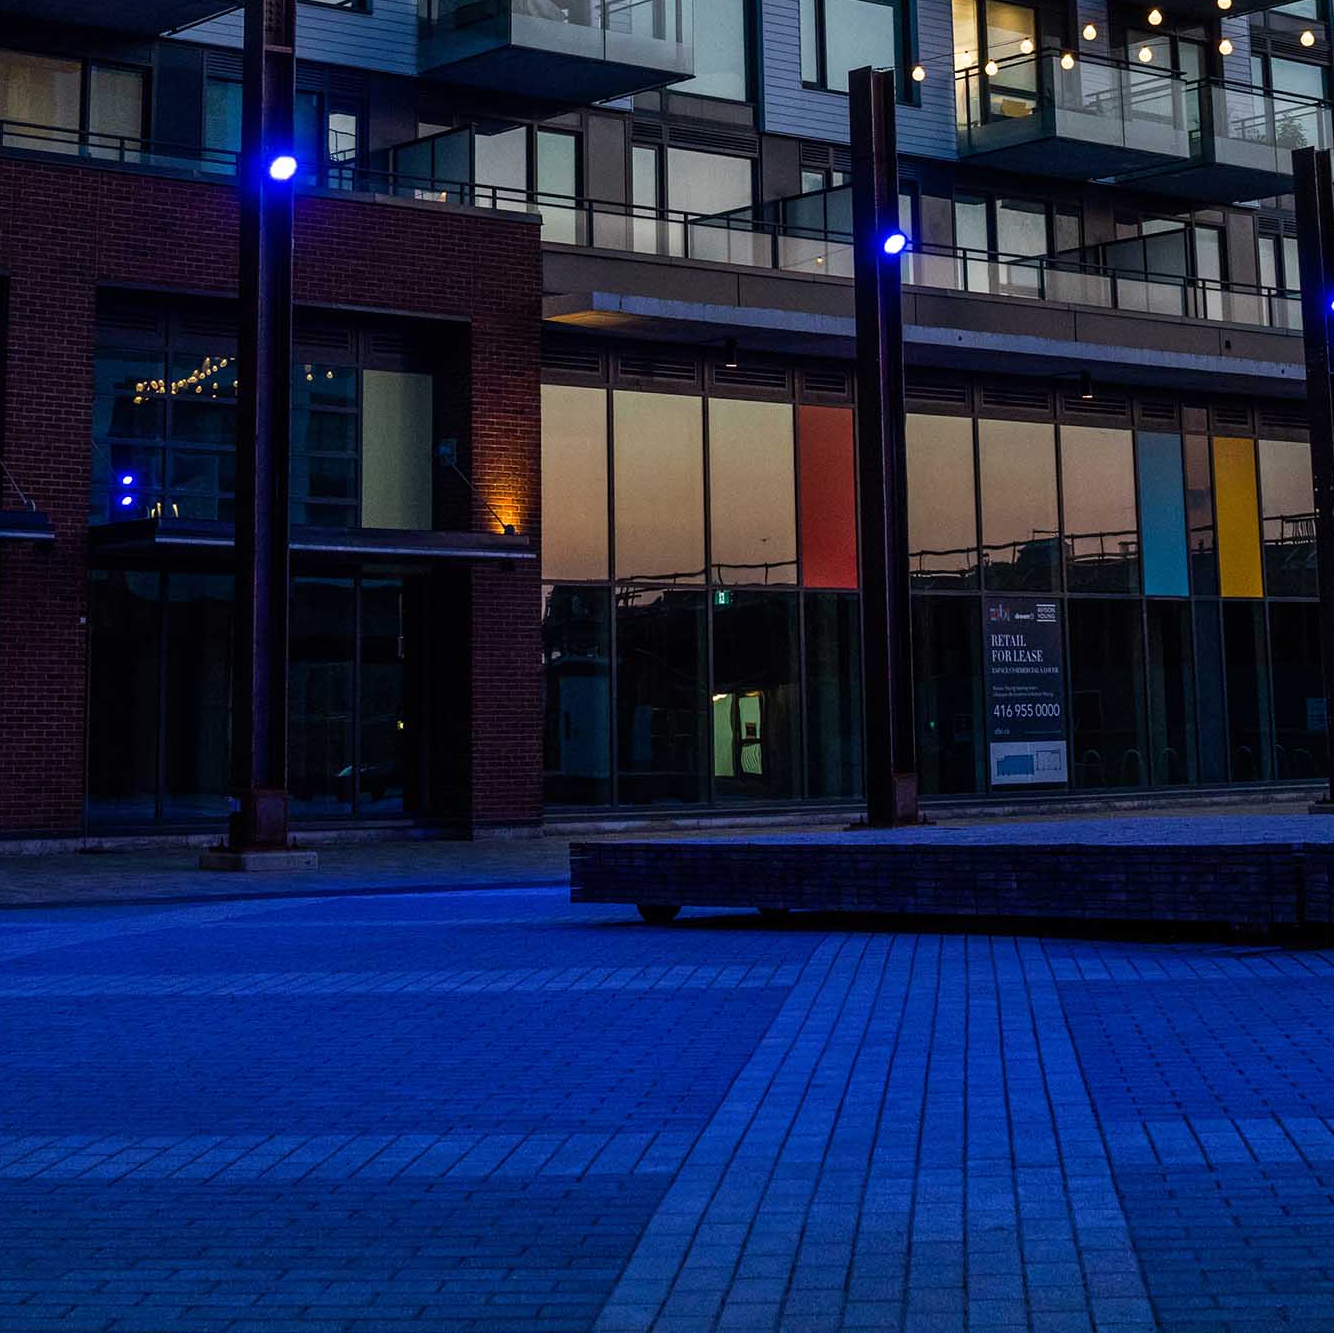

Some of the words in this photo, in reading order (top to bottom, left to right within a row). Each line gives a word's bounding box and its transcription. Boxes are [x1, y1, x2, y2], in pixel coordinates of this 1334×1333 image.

[991, 634, 1027, 647] RETAIL
[991, 649, 1012, 662] FOR
[1013, 649, 1044, 662] LEASE
[993, 704, 1013, 717] 416
[1014, 704, 1034, 717] 955
[1035, 703, 1060, 717] 0000
